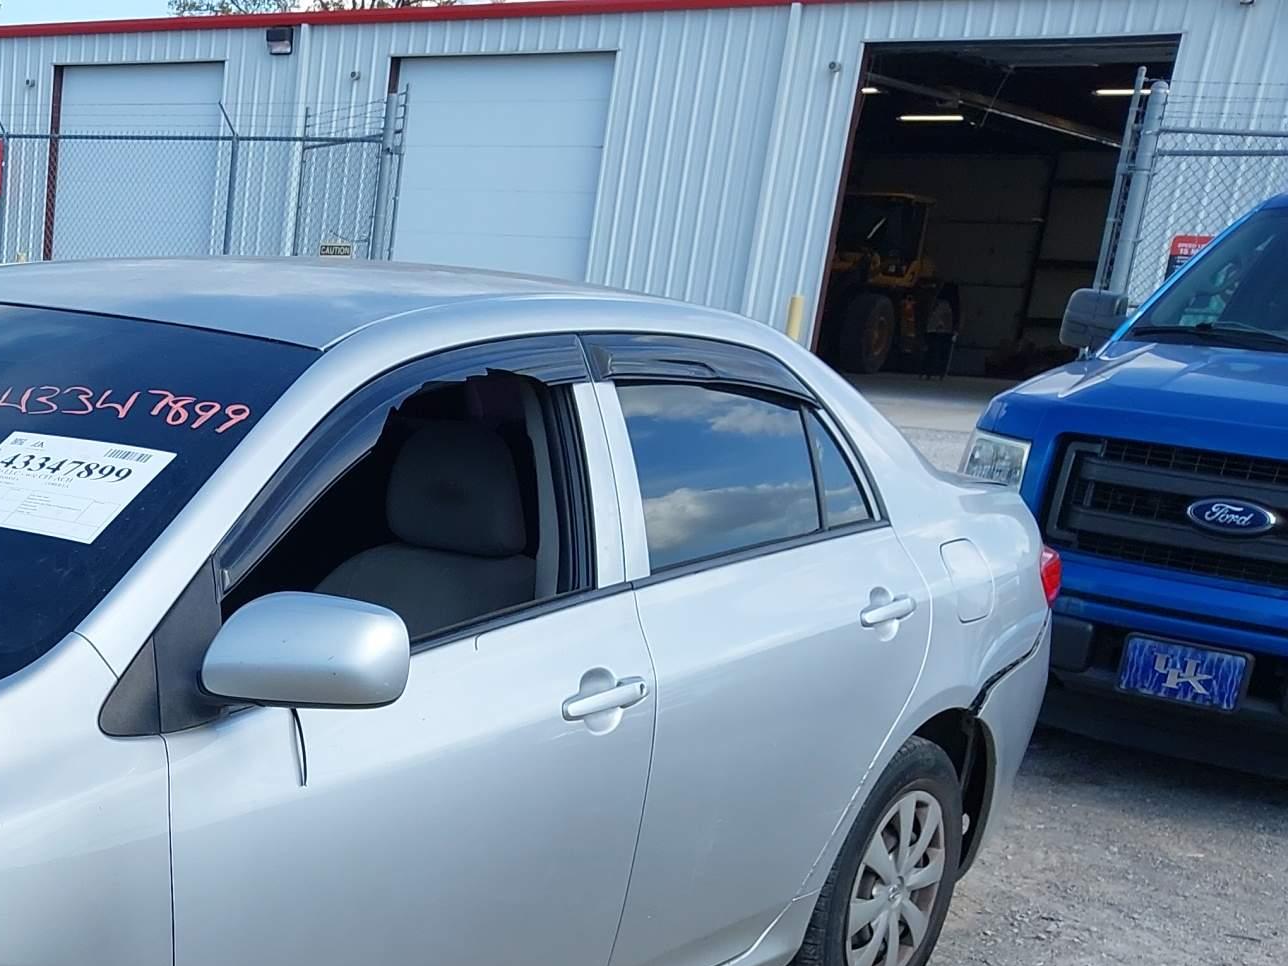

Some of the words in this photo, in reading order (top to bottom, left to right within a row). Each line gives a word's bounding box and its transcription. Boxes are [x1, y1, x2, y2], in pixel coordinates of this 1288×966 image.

[321, 246, 350, 255] CAUTION
[0, 453, 132, 482] 43347899
[1204, 503, 1253, 526] Ford
